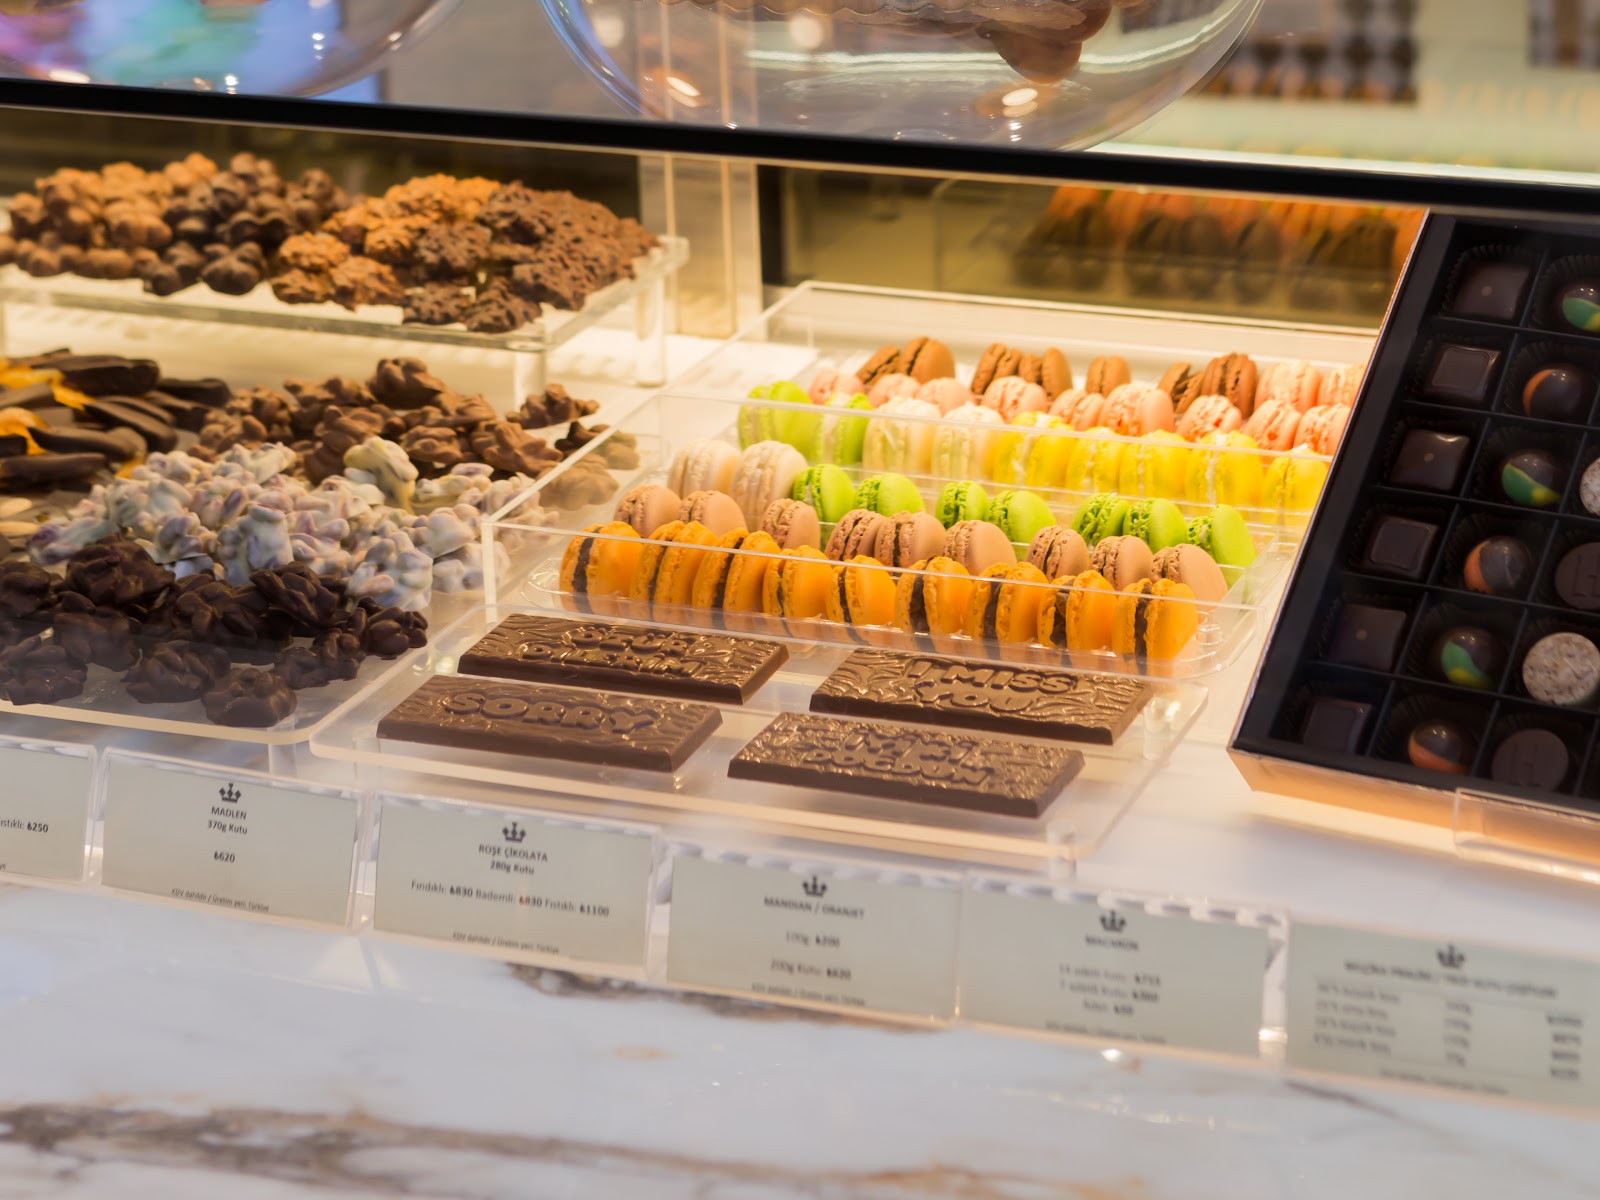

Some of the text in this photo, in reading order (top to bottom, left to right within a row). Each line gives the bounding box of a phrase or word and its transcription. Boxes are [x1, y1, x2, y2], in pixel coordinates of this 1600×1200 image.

[940, 665, 1073, 694] MISS
[914, 679, 1037, 712] YOU
[445, 692, 660, 733] SORRY
[211, 806, 247, 820] MADLEN
[228, 823, 248, 835] Kutu
